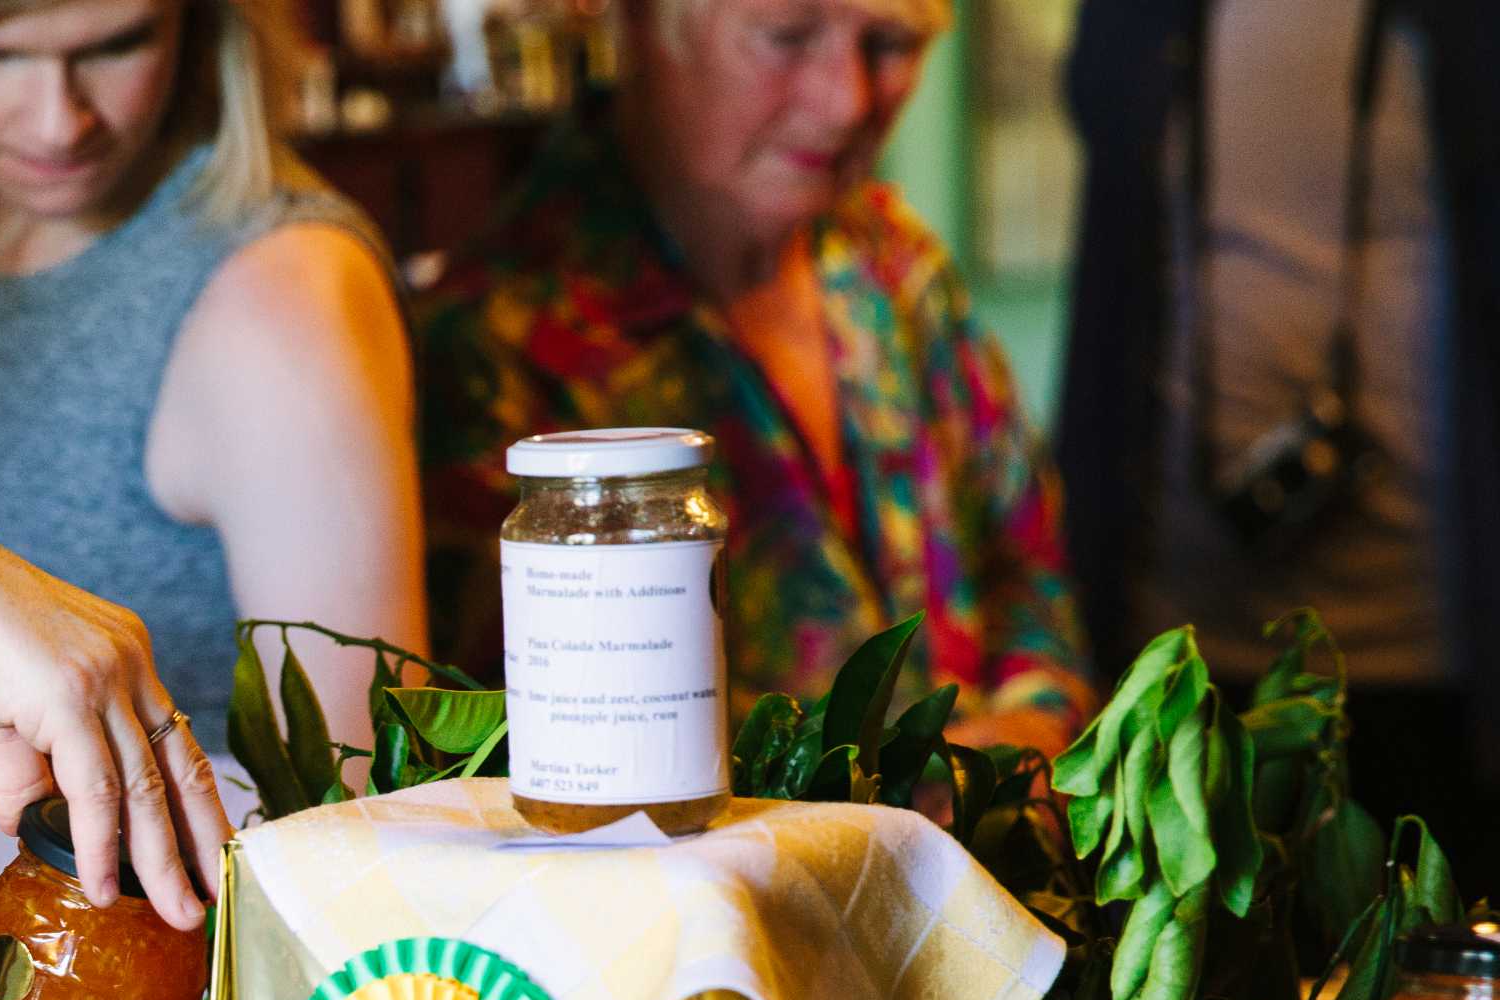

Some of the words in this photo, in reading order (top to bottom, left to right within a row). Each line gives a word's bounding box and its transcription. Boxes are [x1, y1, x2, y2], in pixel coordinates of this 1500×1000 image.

[526, 585, 590, 599] Marmalade
[595, 586, 622, 598] with
[627, 584, 687, 598] Additions
[551, 638, 594, 651] Colada
[599, 639, 674, 652] Marmalade
[550, 692, 578, 706] juice
[582, 692, 605, 704] and
[642, 691, 689, 705] coconut
[550, 711, 608, 724] pineapple
[652, 710, 679, 721] rum
